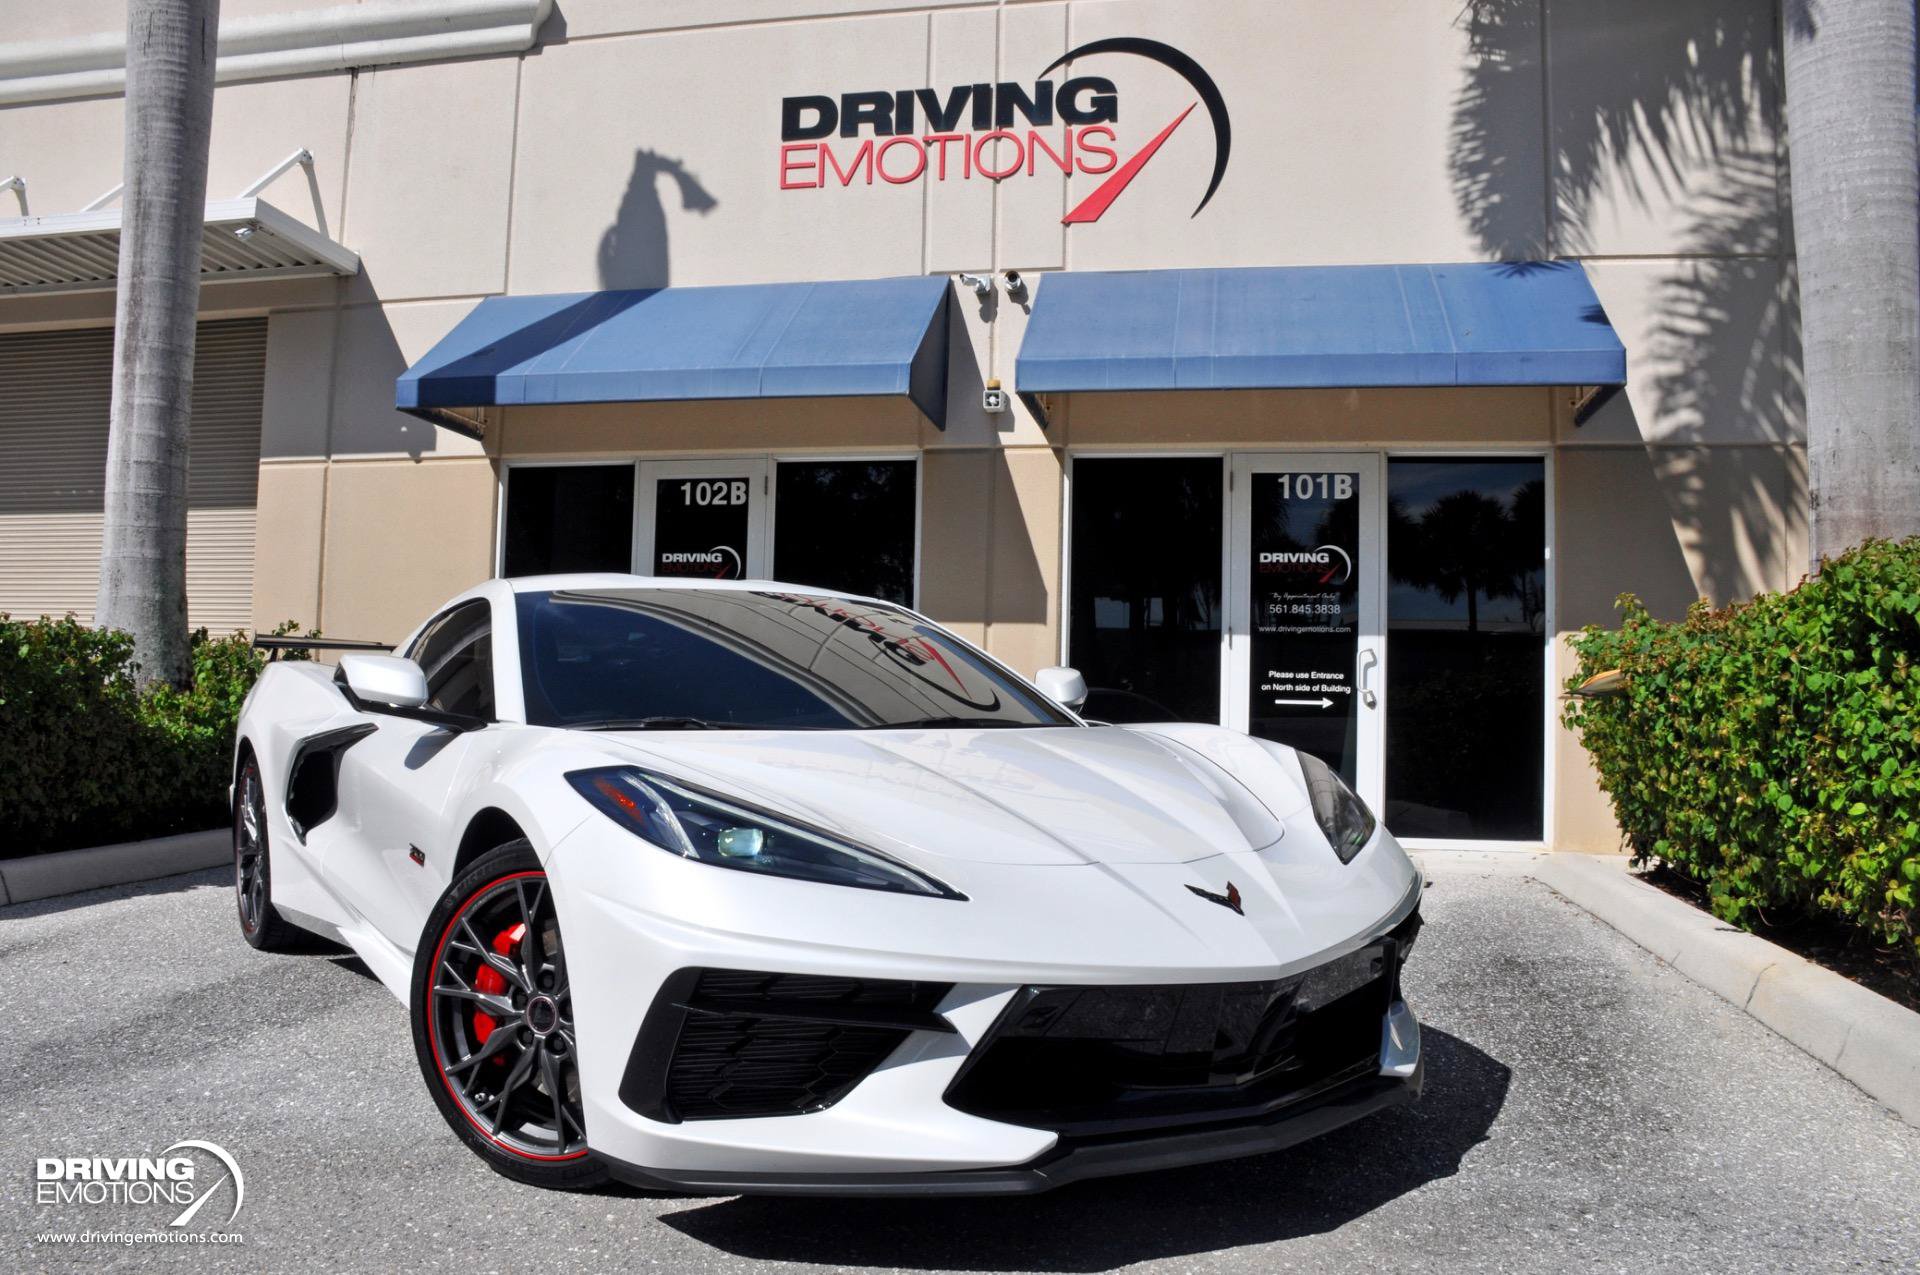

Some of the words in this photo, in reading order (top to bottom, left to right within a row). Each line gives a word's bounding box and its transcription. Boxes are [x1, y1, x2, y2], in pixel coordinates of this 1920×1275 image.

[781, 76, 1118, 141] DRIVING
[780, 126, 1118, 190] EMOTIONS
[1278, 474, 1353, 500] 101B
[680, 481, 747, 506] 102B
[662, 552, 723, 563] DRIVING
[1259, 552, 1330, 563] DRIVING
[1269, 604, 1341, 614] 561.845.3838
[1258, 624, 1351, 635] www.drivingemotions.com
[1268, 670, 1294, 679] Please
[1310, 671, 1345, 680] Entrance
[1272, 683, 1294, 692] North
[1295, 684, 1311, 692] side
[1312, 684, 1320, 692] of
[1321, 684, 1352, 695] Building
